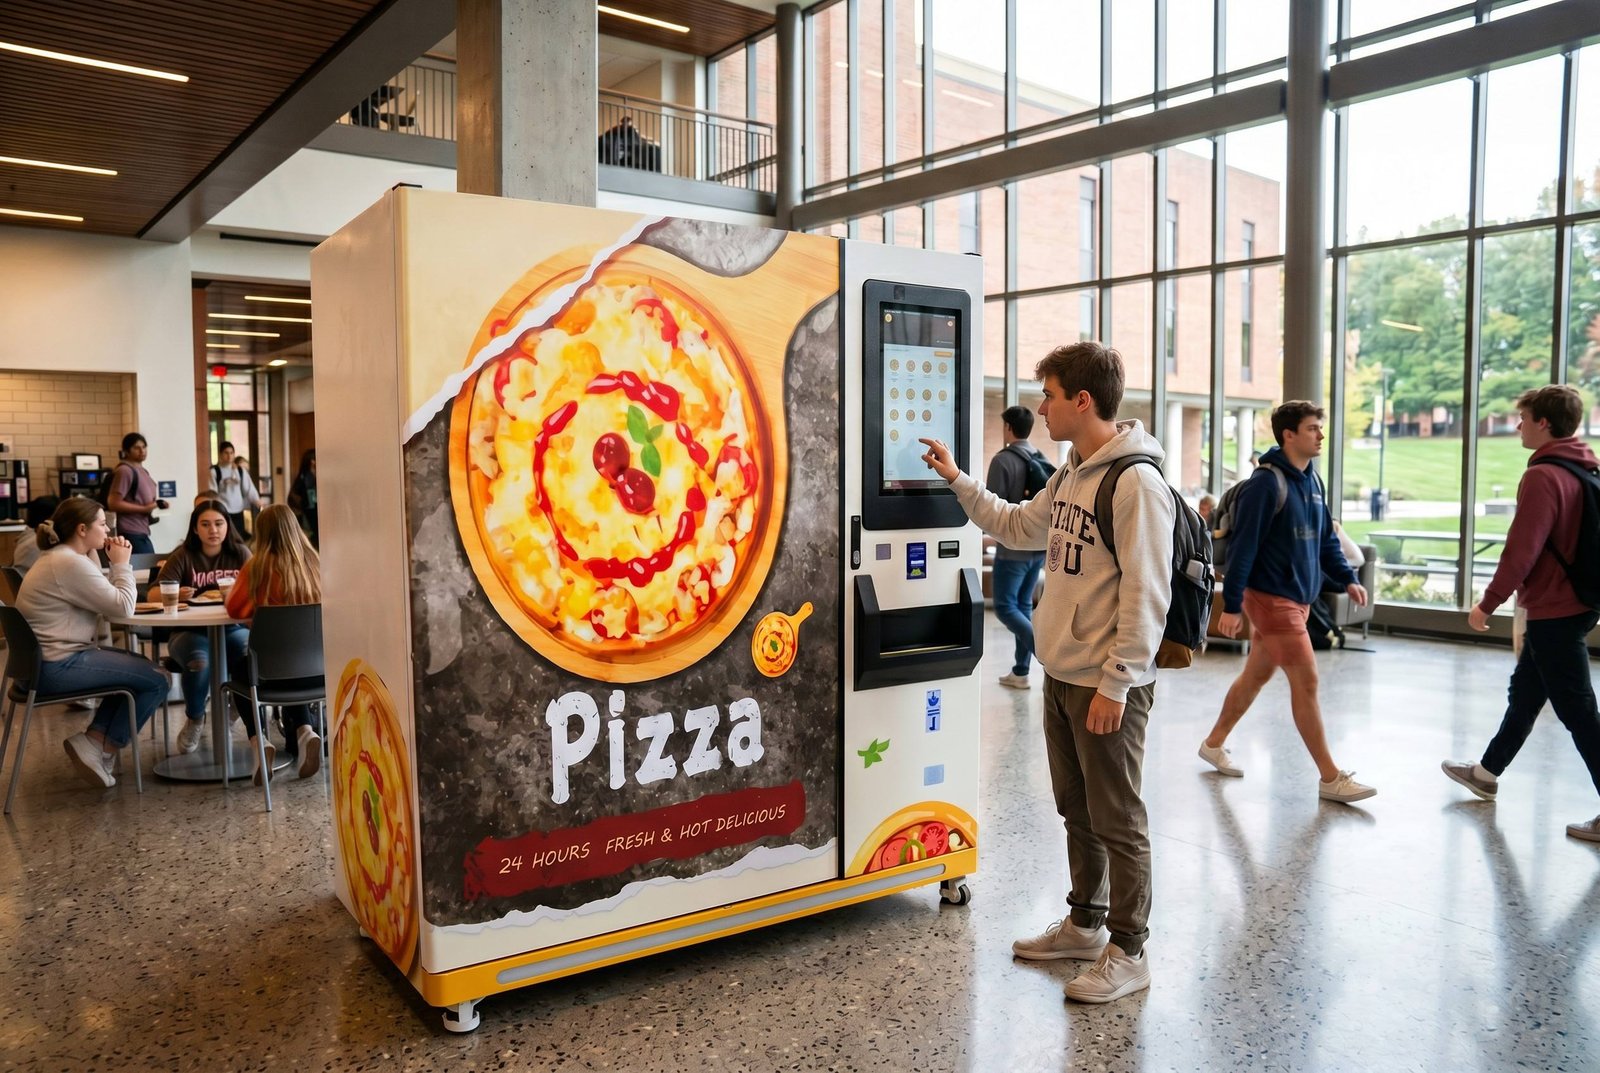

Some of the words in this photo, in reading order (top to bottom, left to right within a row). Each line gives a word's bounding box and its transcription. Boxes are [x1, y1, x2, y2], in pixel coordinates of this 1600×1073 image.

[545, 689, 765, 805] Pizza
[499, 856, 522, 874] 24
[532, 842, 590, 869] HOURS
[605, 831, 655, 855] FRESH
[660, 828, 672, 842] &
[680, 819, 712, 839] HOT
[715, 804, 786, 832] DELICIOUS
